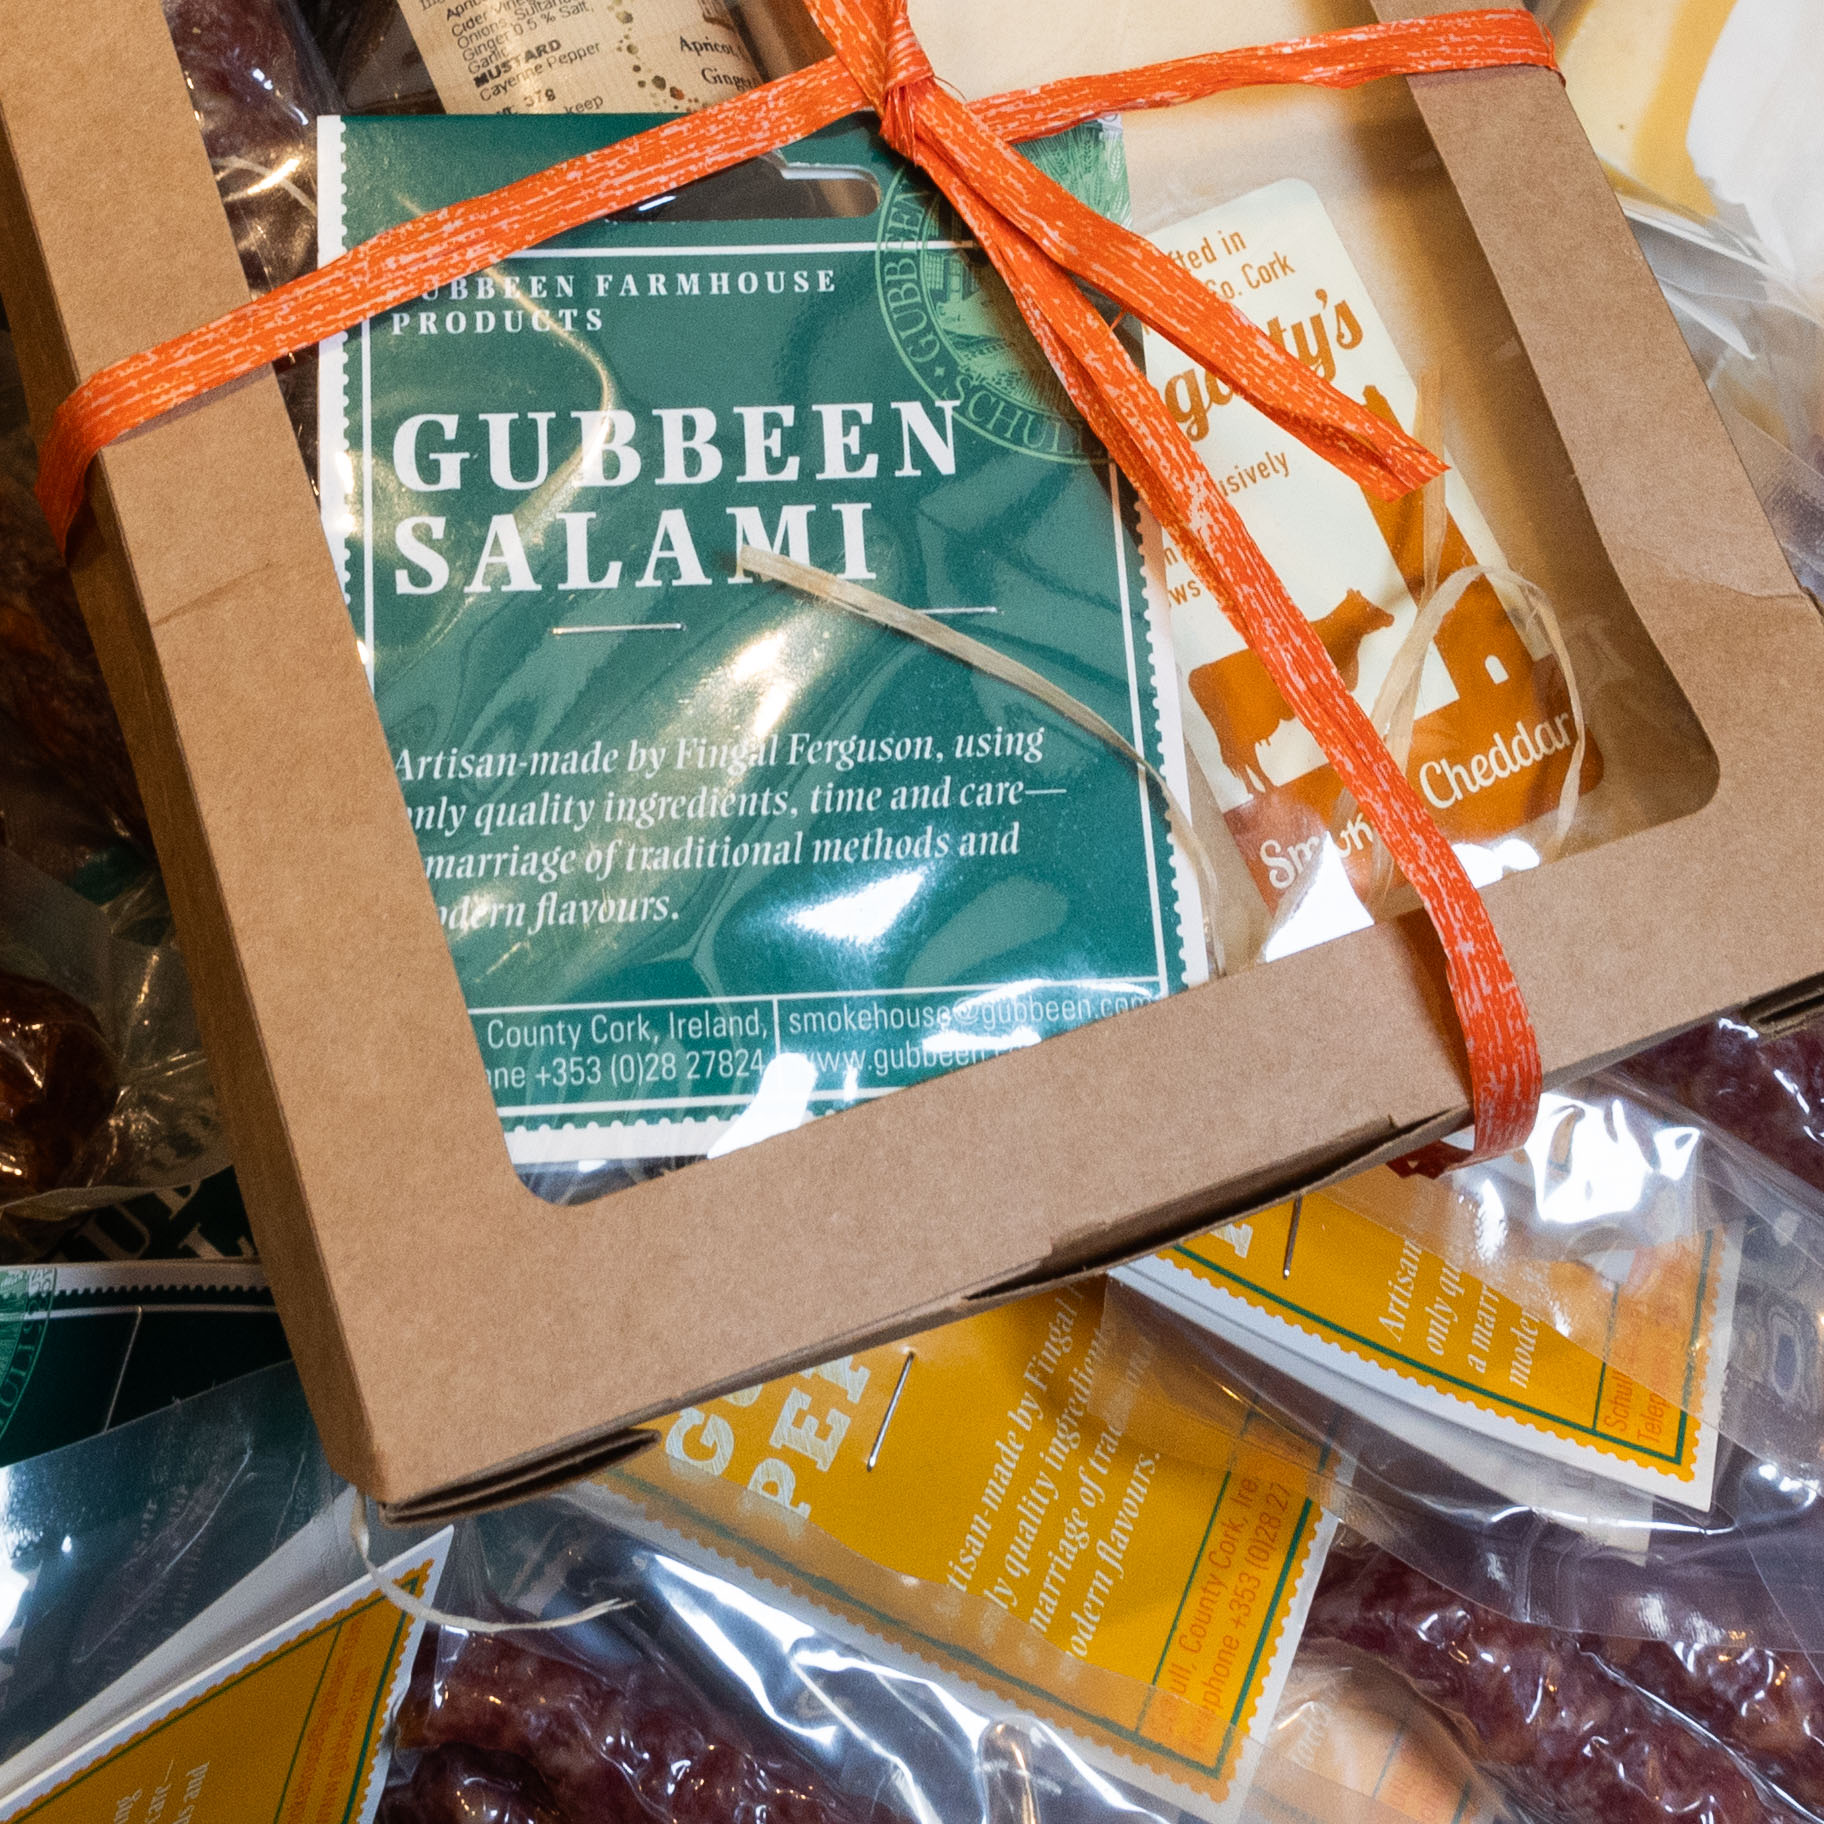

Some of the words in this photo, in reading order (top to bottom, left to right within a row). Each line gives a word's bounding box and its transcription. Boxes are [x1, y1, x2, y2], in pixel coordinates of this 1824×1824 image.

[450, 10, 489, 38] Cider
[461, 30, 511, 64] Ginger
[540, 9, 556, 24] %
[467, 47, 509, 75] Garlic
[473, 39, 562, 88] MUSTARD
[478, 60, 544, 102] Cayenne
[547, 41, 602, 71] Pepper
[1214, 227, 1246, 255] in
[1247, 251, 1297, 287] Cork
[417, 273, 577, 305] UBBEEN
[596, 269, 839, 299] FARMHOUSE
[390, 307, 607, 338] PRODUCTS
[392, 399, 963, 494] GUBBEEN
[393, 501, 881, 598] SALAMI
[391, 741, 620, 784] Artisan-made
[626, 738, 667, 778] by
[675, 734, 777, 778] Fingal
[786, 729, 945, 773] Ferguson,
[953, 724, 1045, 764] using
[1418, 709, 1575, 810] Cheddar
[473, 789, 595, 834] quality
[602, 786, 802, 829] ingredients,
[809, 779, 883, 813] time
[891, 775, 950, 809] and
[424, 840, 578, 882] marriage
[584, 835, 619, 878] of
[626, 827, 803, 869] traditional
[811, 825, 950, 864] methods
[958, 821, 1021, 857] and
[529, 888, 680, 936] flavours.
[488, 1013, 581, 1052] County
[590, 1008, 661, 1047] Cork,
[668, 1006, 769, 1042] Ireland,
[534, 1051, 603, 1087] +353
[609, 1049, 678, 1085] (0)28
[685, 1046, 766, 1080] 27824
[1378, 1239, 1423, 1343] Artisan
[1024, 1299, 1079, 1397] Fingal
[1423, 1293, 1458, 1358] only
[1468, 1352, 1486, 1374] a
[1008, 1393, 1045, 1441] by
[946, 1433, 1025, 1594] tisan-made
[1078, 1467, 1108, 1509] of
[1005, 1462, 1062, 1579] quality
[1067, 1574, 1116, 1658] odern
[1095, 1450, 1161, 1579] flavours.
[1179, 1564, 1228, 1654] County
[1208, 1510, 1249, 1567] Cork,
[1229, 1573, 1262, 1630] +353
